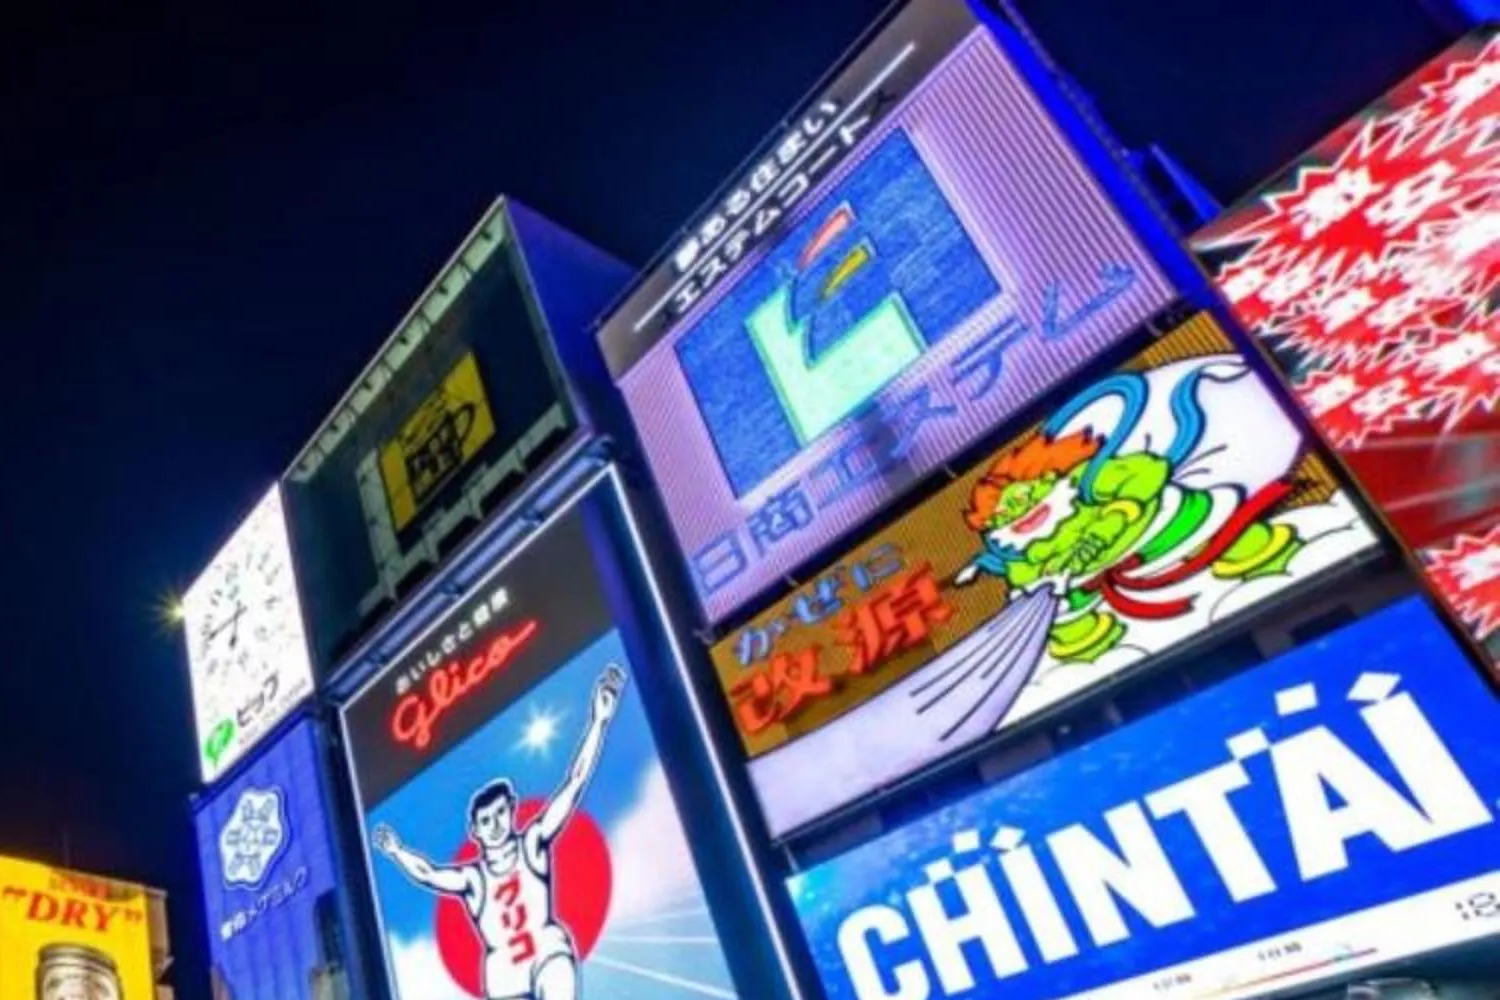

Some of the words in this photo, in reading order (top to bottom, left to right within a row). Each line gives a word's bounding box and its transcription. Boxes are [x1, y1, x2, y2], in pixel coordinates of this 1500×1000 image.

[692, 262, 1137, 594] 日商エステム
[391, 620, 538, 749] Glico
[731, 562, 956, 733] 改源
[494, 870, 536, 965] グリコ
